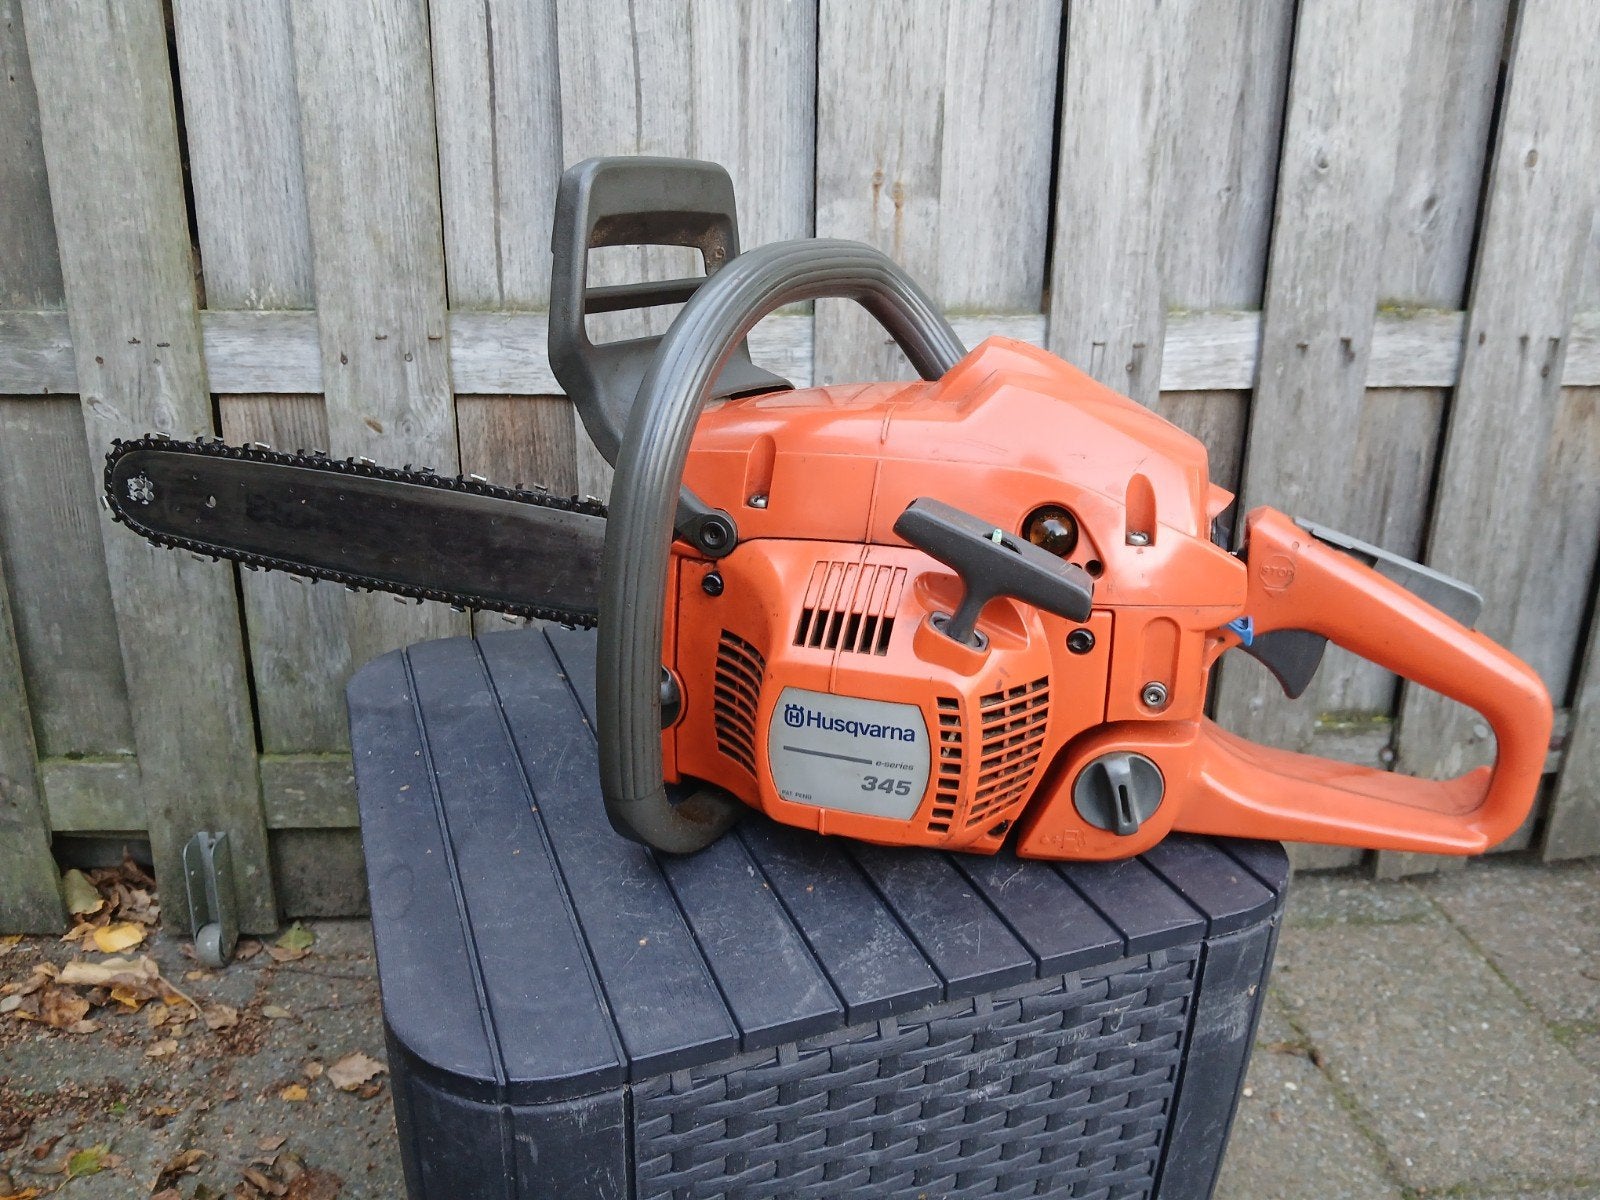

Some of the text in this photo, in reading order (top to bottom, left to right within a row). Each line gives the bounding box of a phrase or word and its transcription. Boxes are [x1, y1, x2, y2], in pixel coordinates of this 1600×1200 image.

[806, 710, 916, 742] Husqvarna
[875, 760, 914, 771] e-series
[861, 775, 912, 796] 345
